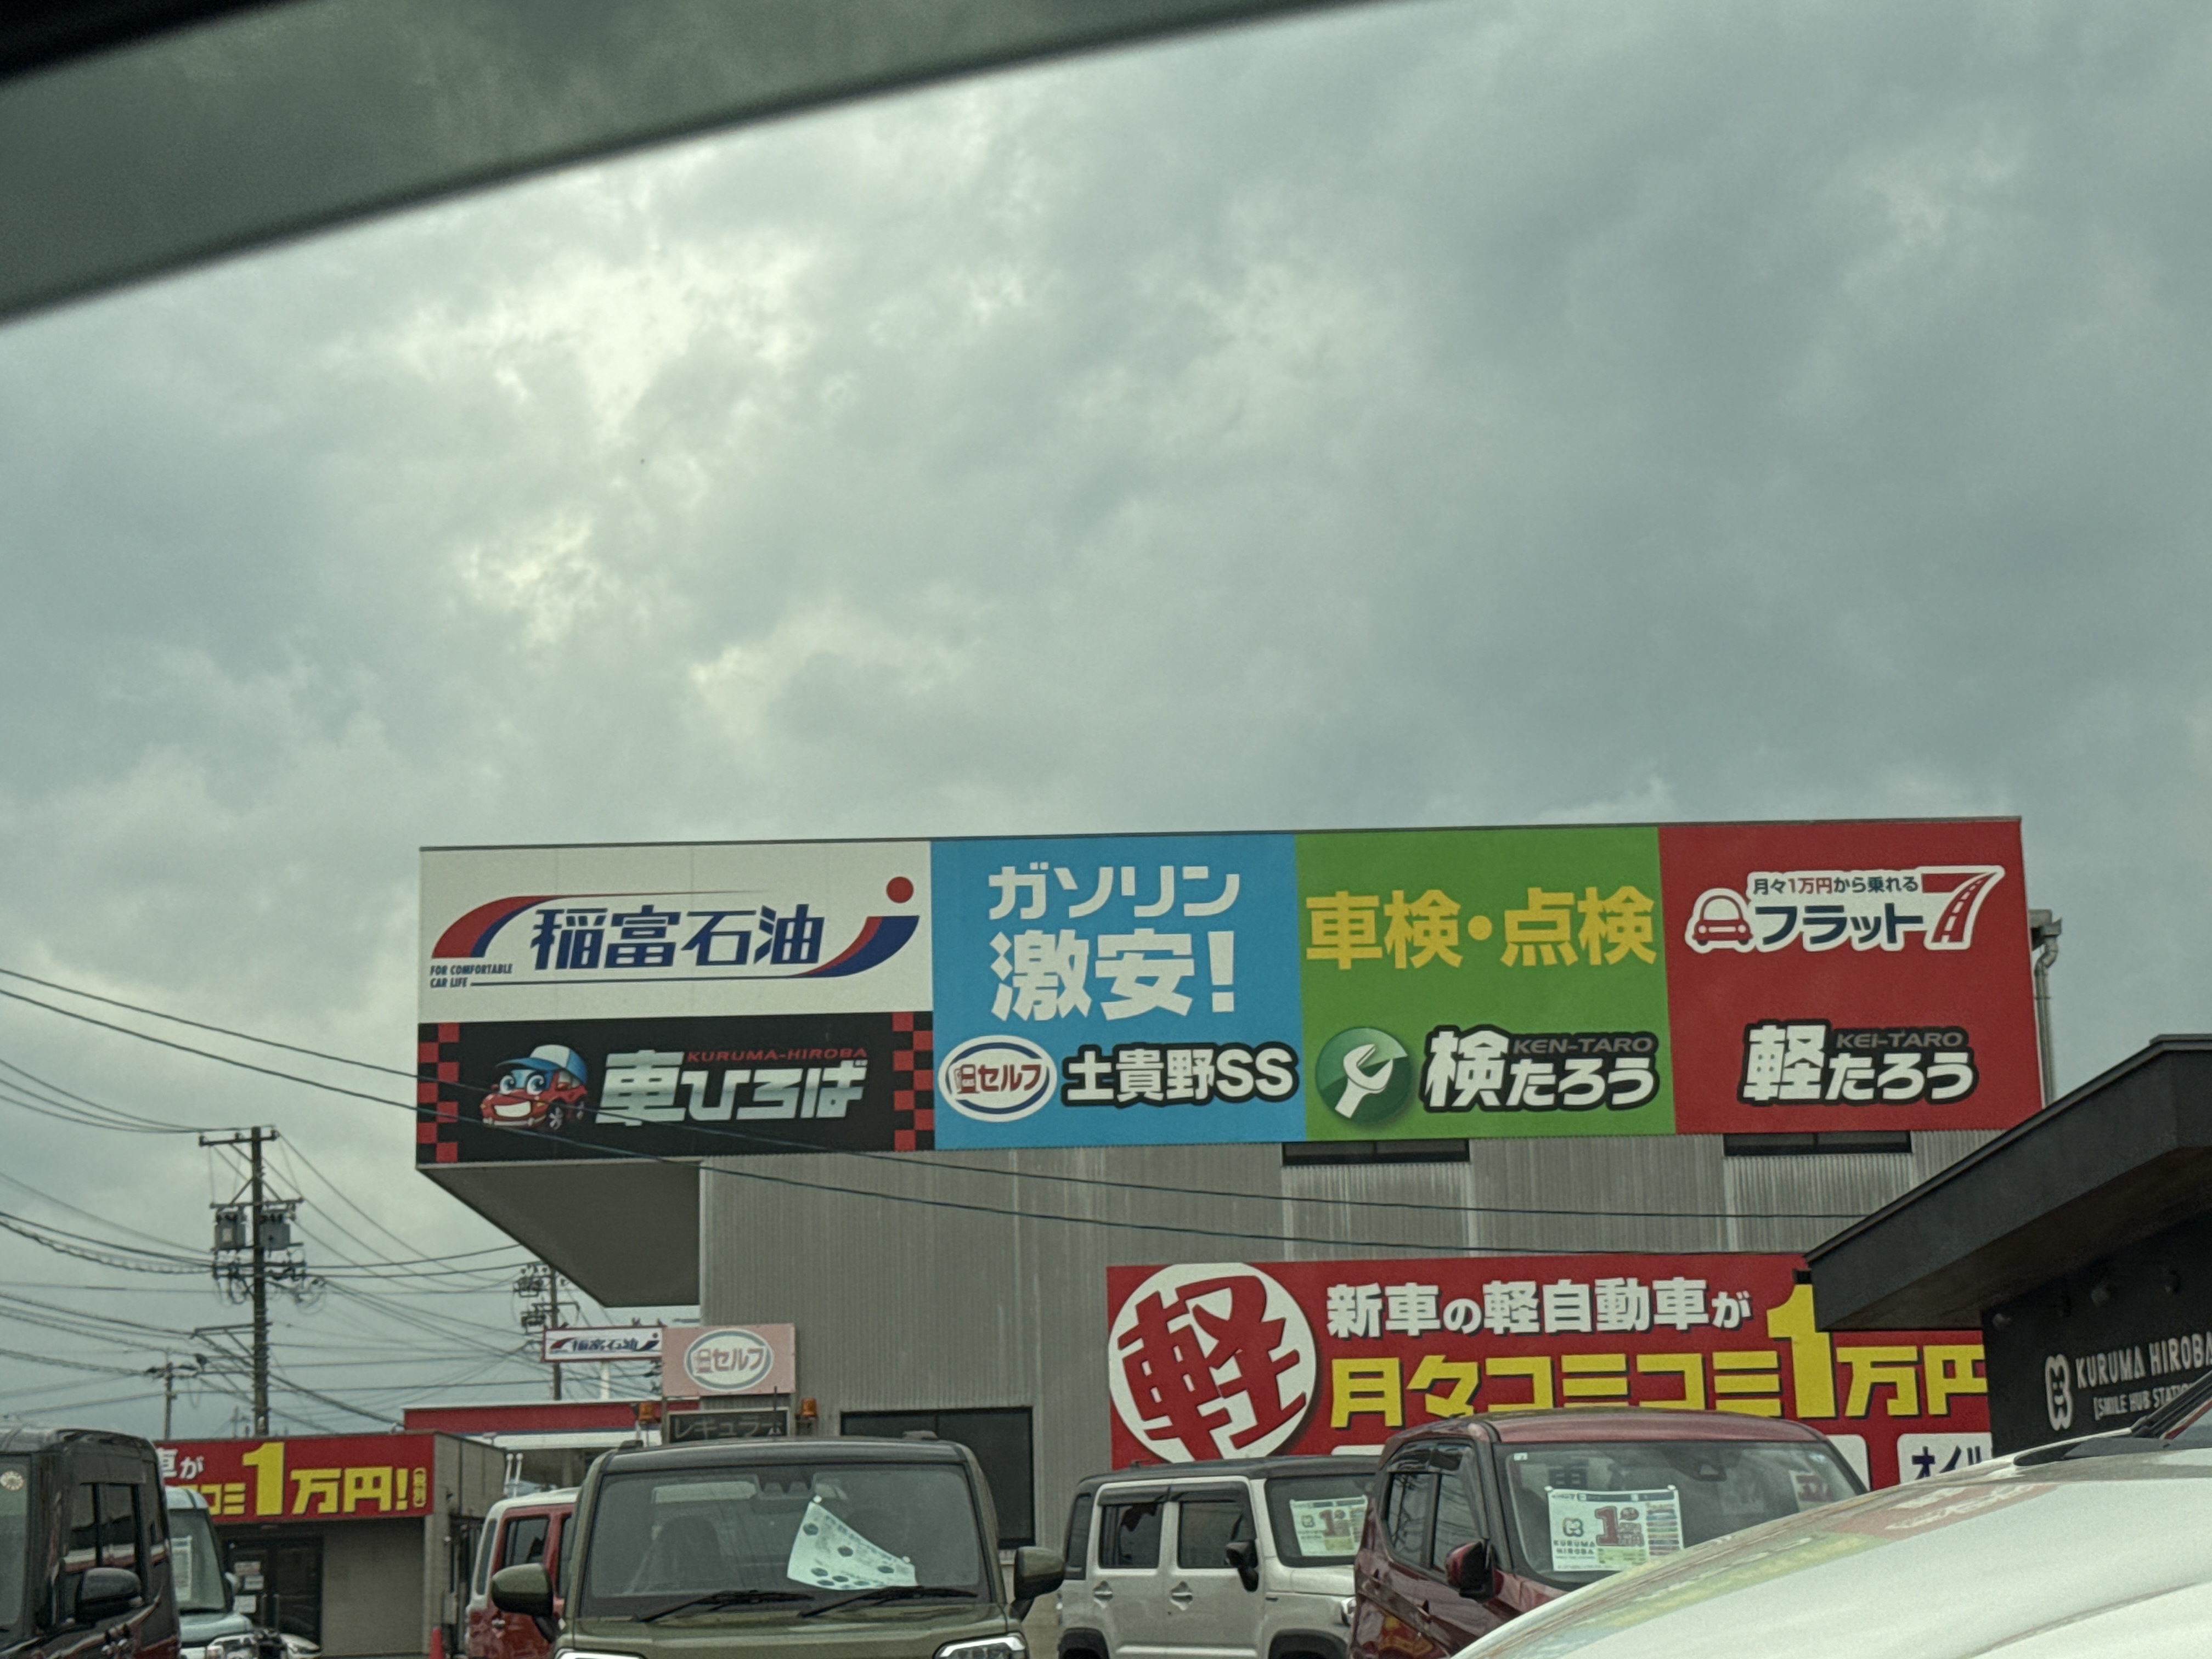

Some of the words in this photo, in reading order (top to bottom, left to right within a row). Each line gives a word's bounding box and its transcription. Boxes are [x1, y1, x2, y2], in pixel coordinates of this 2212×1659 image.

[989, 862, 1240, 919] ガソリン
[1753, 876, 1918, 895] 月々1万円から乗れる
[531, 904, 825, 970] 稲富石油
[1306, 886, 1657, 970] 車検・点検
[430, 964, 448, 976] FOR
[450, 963, 513, 975] COMFORTABLE
[430, 978, 448, 988] CAR
[450, 977, 467, 988] LIFE
[990, 928, 1234, 1021] 激安!
[687, 1048, 867, 1063] KURUMA-HIROBA
[1513, 1037, 1652, 1054] KEN-TARO
[1742, 1025, 1973, 1101] 軽たろう
[1836, 1032, 1963, 1048] KEI-TARO
[595, 1049, 868, 1127] 車ひろば
[978, 1064, 1041, 1092] セルフ
[1066, 1048, 1293, 1101] 土貴野SS
[1425, 1030, 1655, 1108] 検たろう
[1327, 1276, 1751, 1338] 新車の軽自動車が
[713, 1348, 764, 1371] セルフ
[1116, 1276, 1307, 1460] 軽
[2076, 1346, 2146, 1389] KURUMA
[2149, 1331, 2212, 1376] HIROBA
[180, 1441, 408, 1516] コミ1万円!
